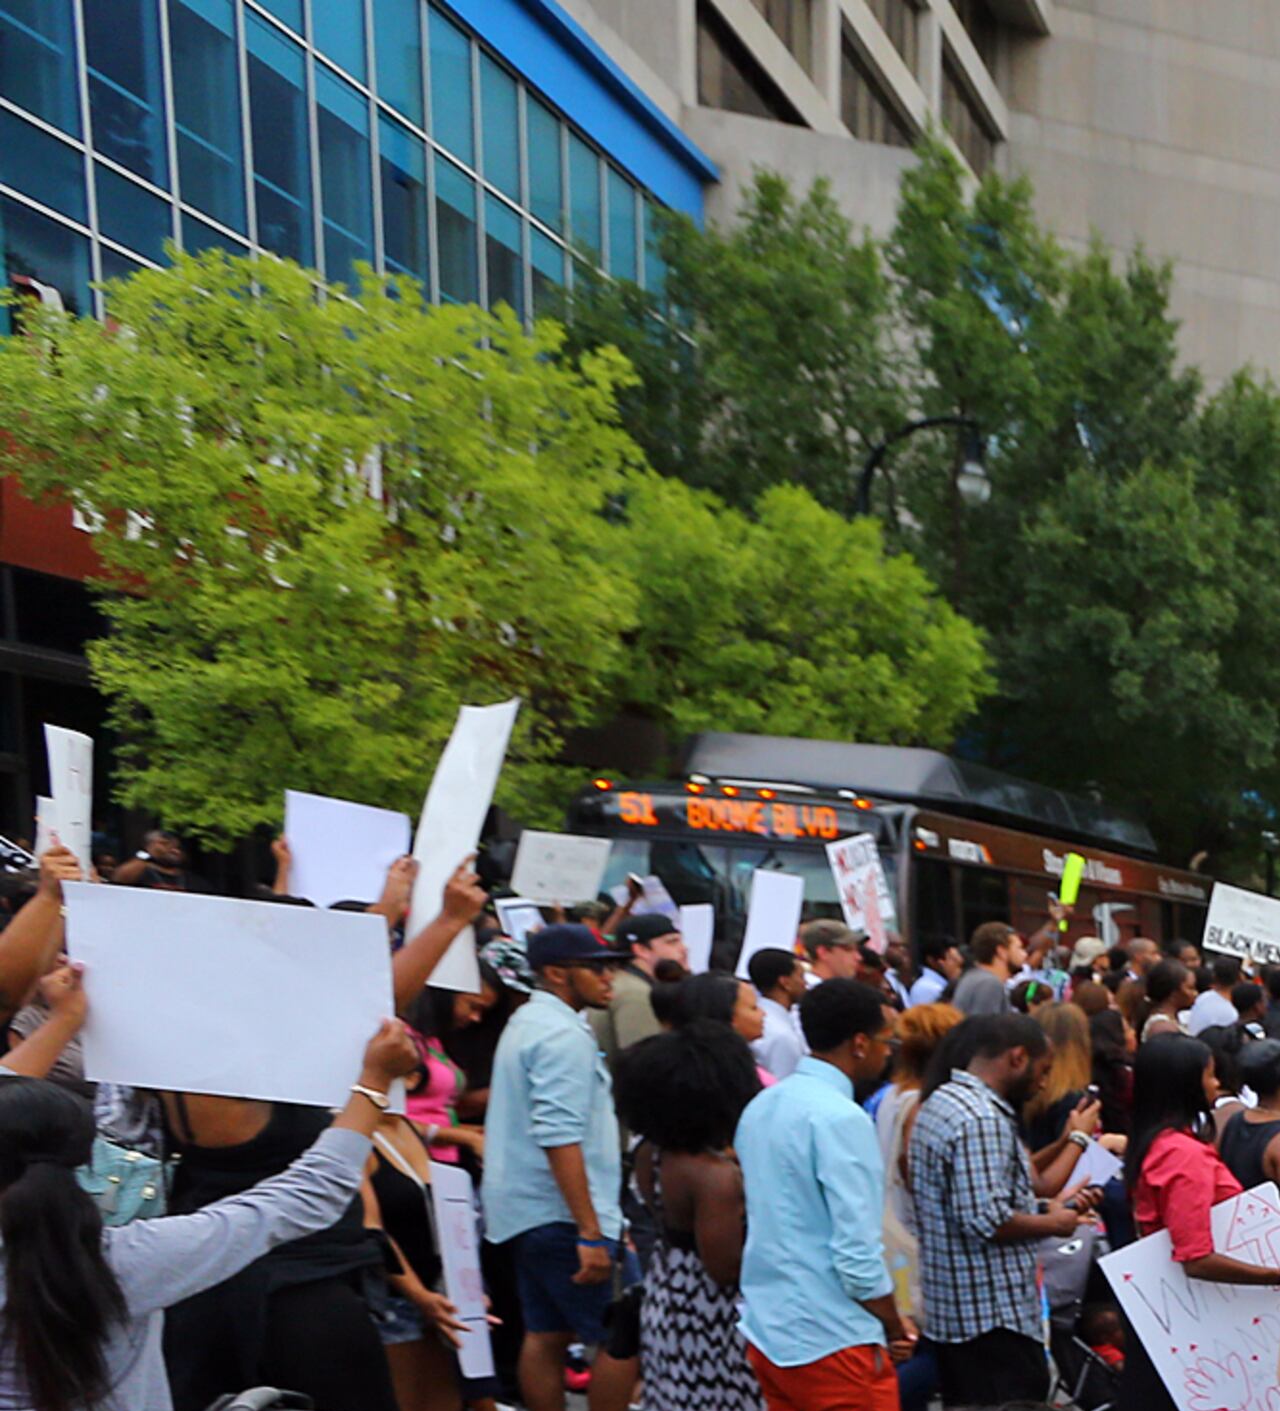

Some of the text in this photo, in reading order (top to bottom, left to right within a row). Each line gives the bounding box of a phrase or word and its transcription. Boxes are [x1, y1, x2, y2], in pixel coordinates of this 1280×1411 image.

[618, 791, 838, 839] 51 BOONE BLVD
